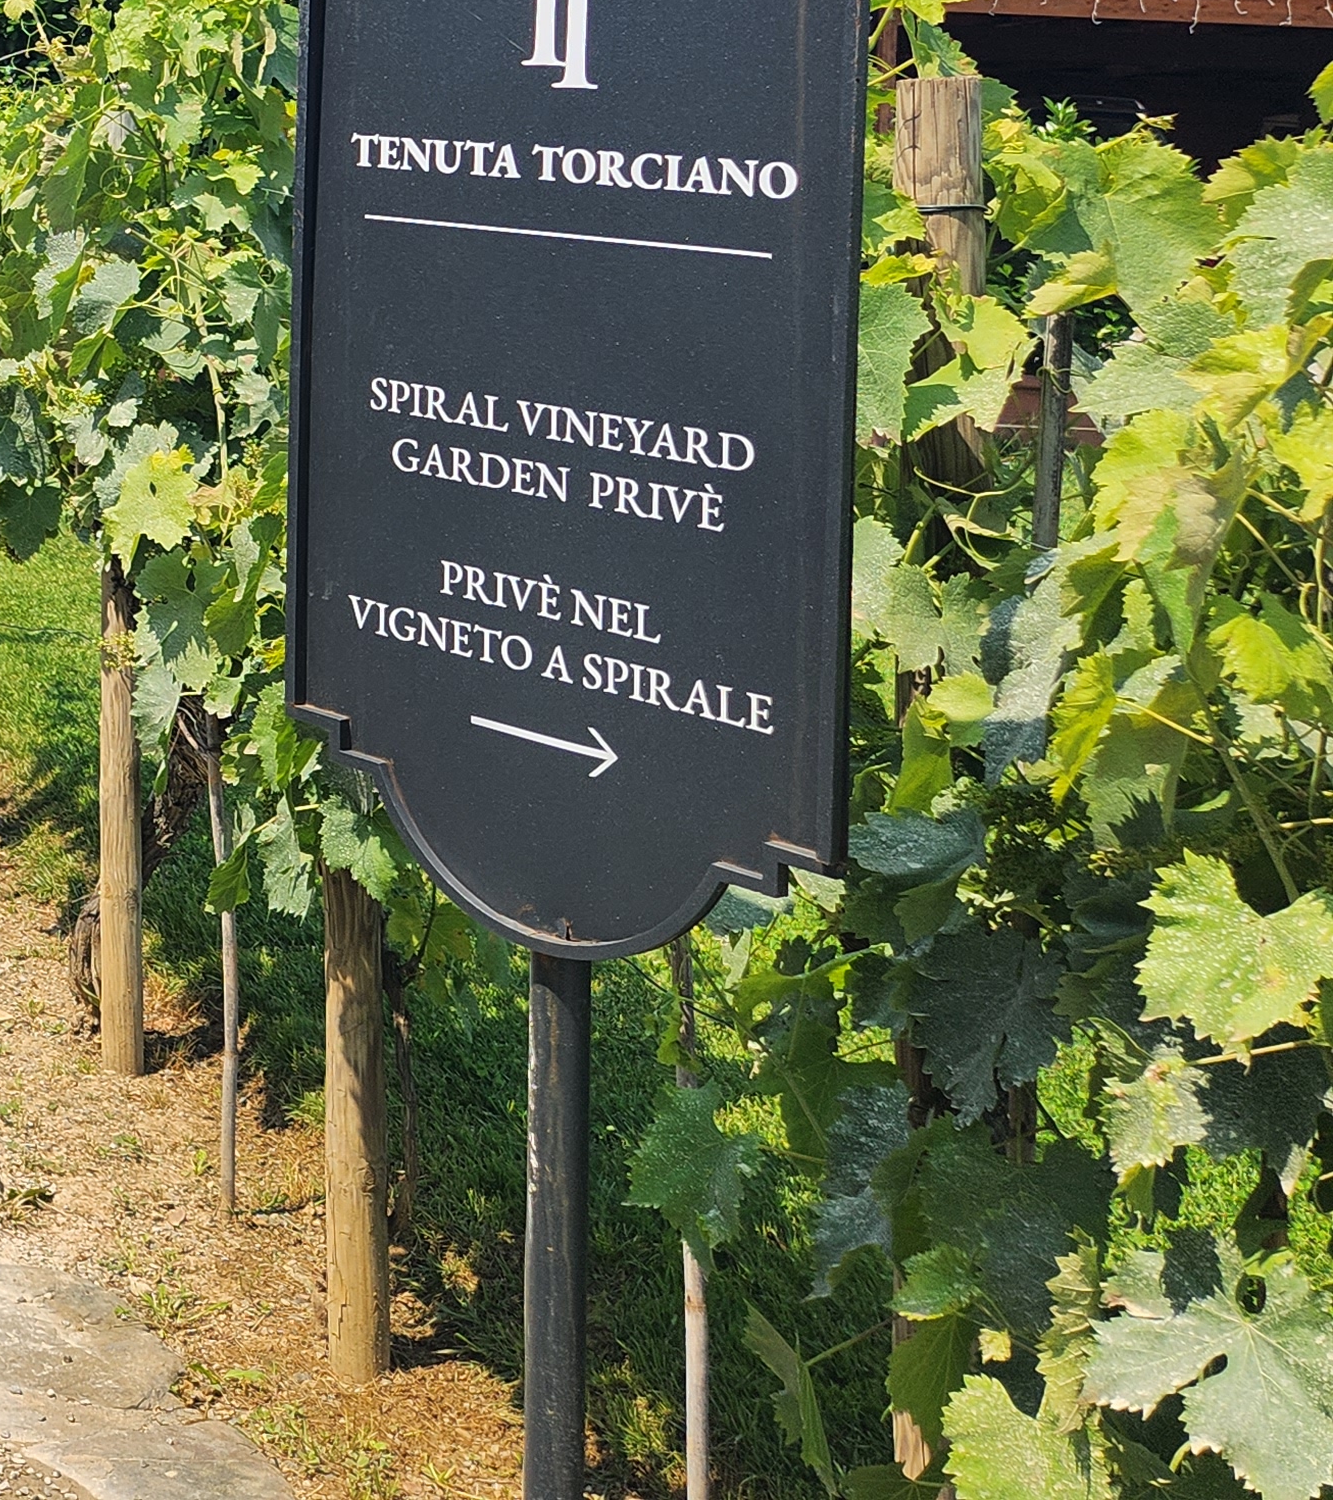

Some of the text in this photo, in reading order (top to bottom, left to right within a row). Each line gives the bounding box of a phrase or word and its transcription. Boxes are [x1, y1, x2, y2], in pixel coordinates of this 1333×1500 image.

[351, 132, 799, 200] TENUTA TORCIANO
[369, 377, 756, 472] SPIRAL VINEYARD
[391, 438, 725, 533] GARDEN PRIVÈ
[439, 559, 662, 645] PRIVÈ NEL
[347, 594, 775, 735] VIGNETO A SPIRALE
